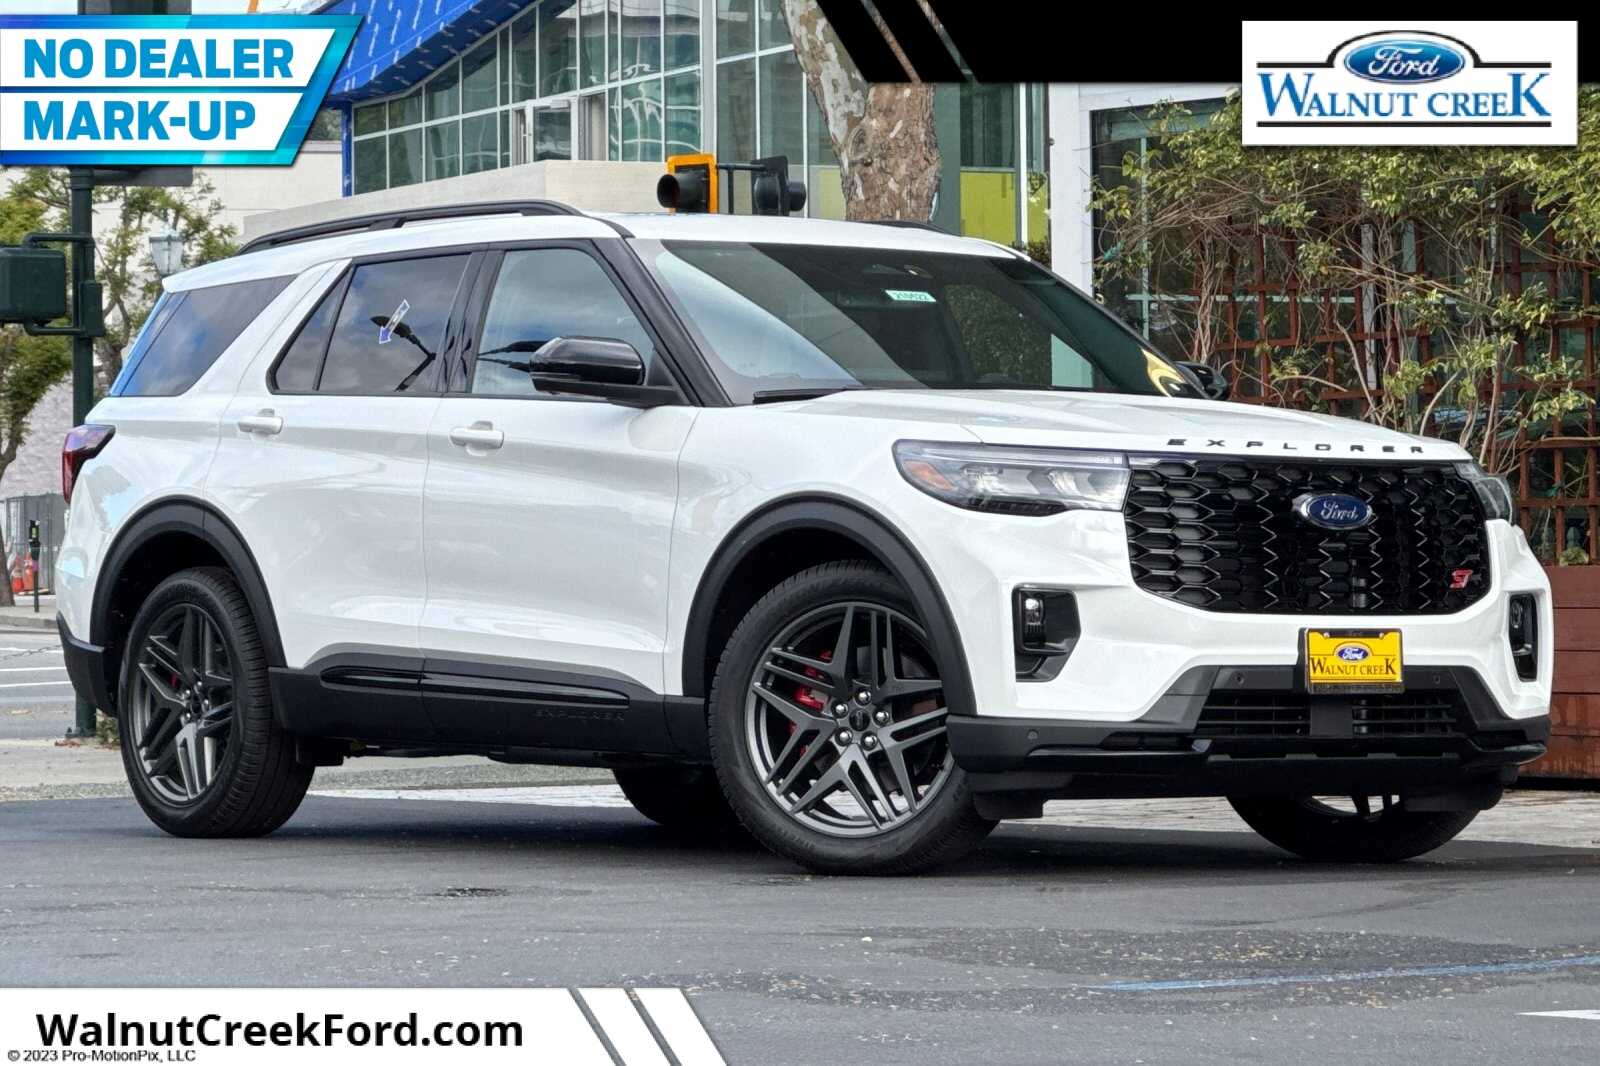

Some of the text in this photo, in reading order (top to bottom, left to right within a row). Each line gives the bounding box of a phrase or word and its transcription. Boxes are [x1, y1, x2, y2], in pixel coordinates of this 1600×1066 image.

[1167, 438, 1424, 454] EXPLORER
[1320, 500, 1359, 520] Ford
[1310, 657, 1396, 675] WALNUT CREEK
